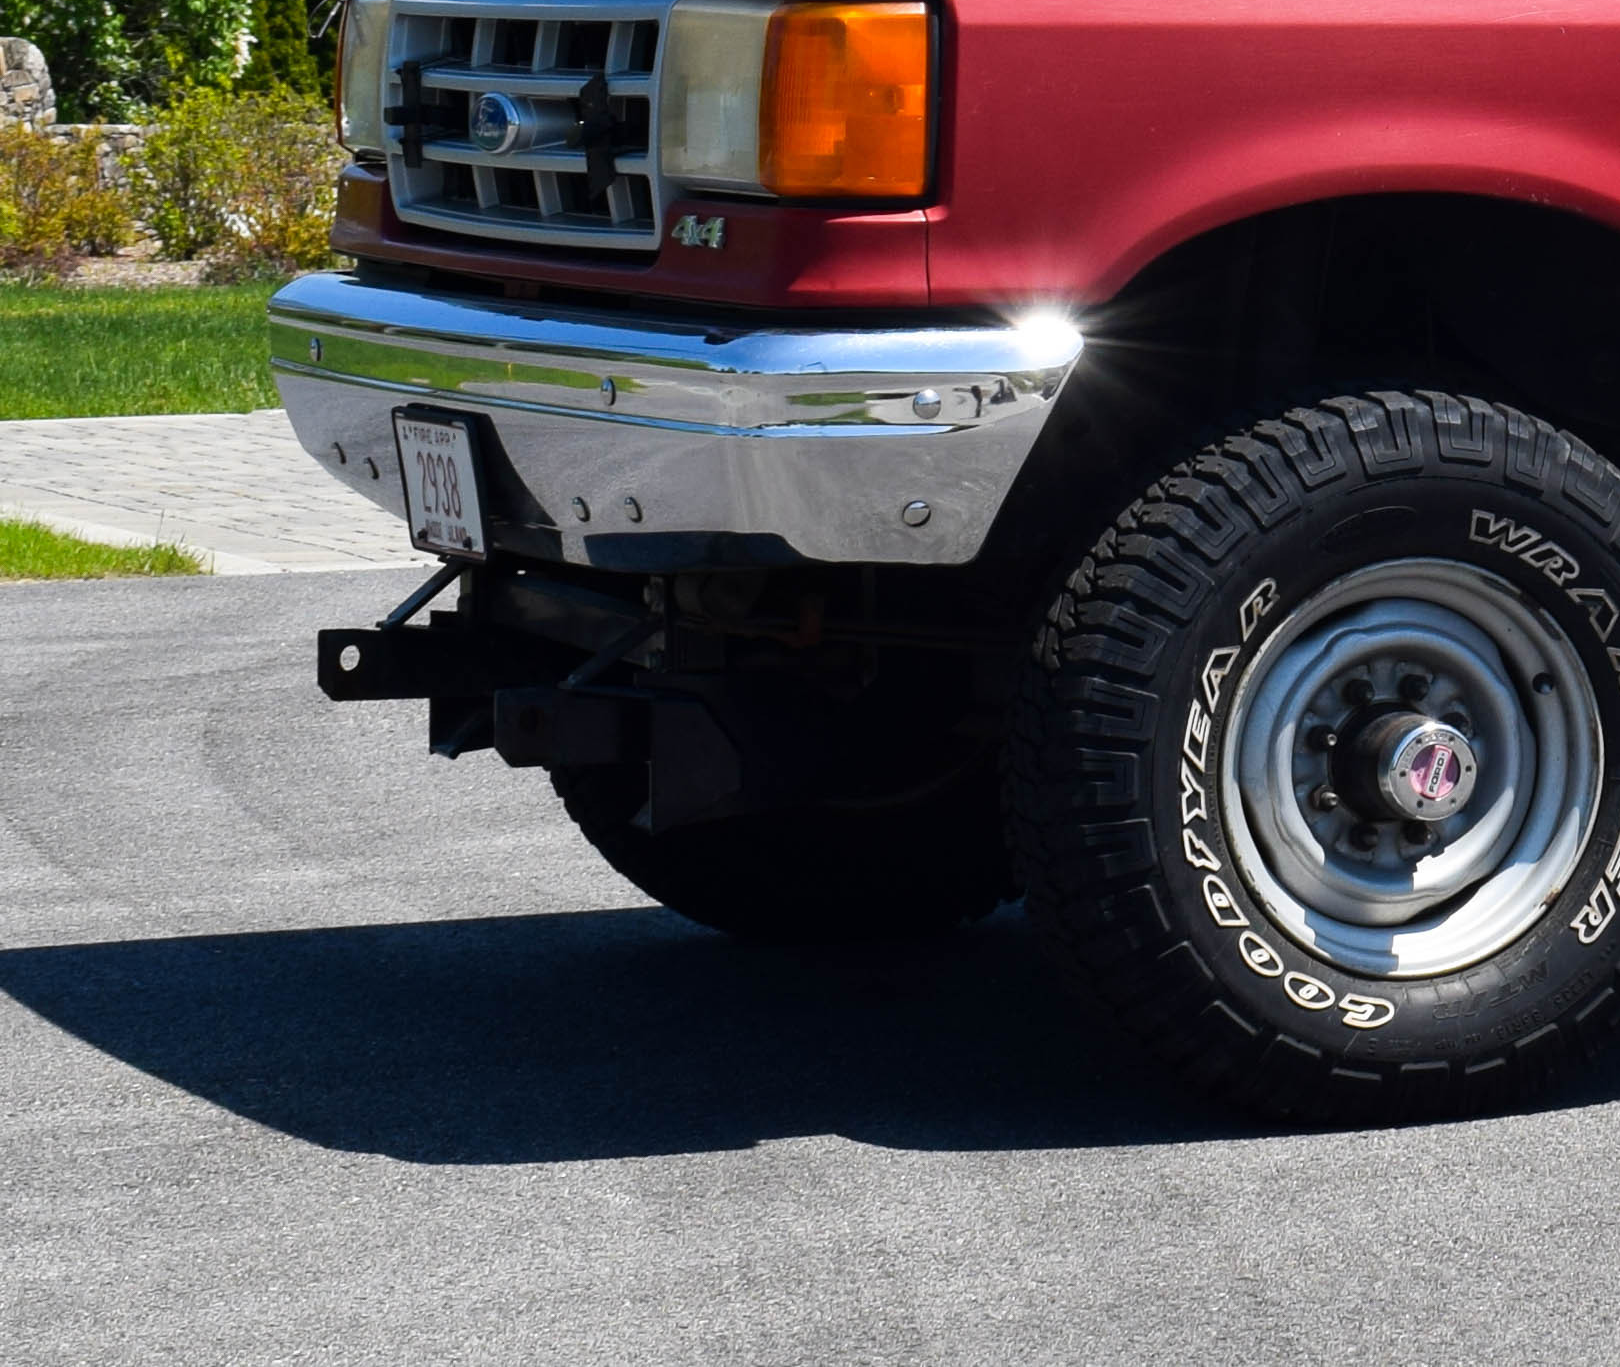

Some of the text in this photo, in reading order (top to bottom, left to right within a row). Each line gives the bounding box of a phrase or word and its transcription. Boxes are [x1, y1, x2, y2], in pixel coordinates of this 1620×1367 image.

[416, 450, 462, 520] 2938
[1181, 578, 1395, 1029] GOODYEAR
[1428, 756, 1446, 793] FORD
